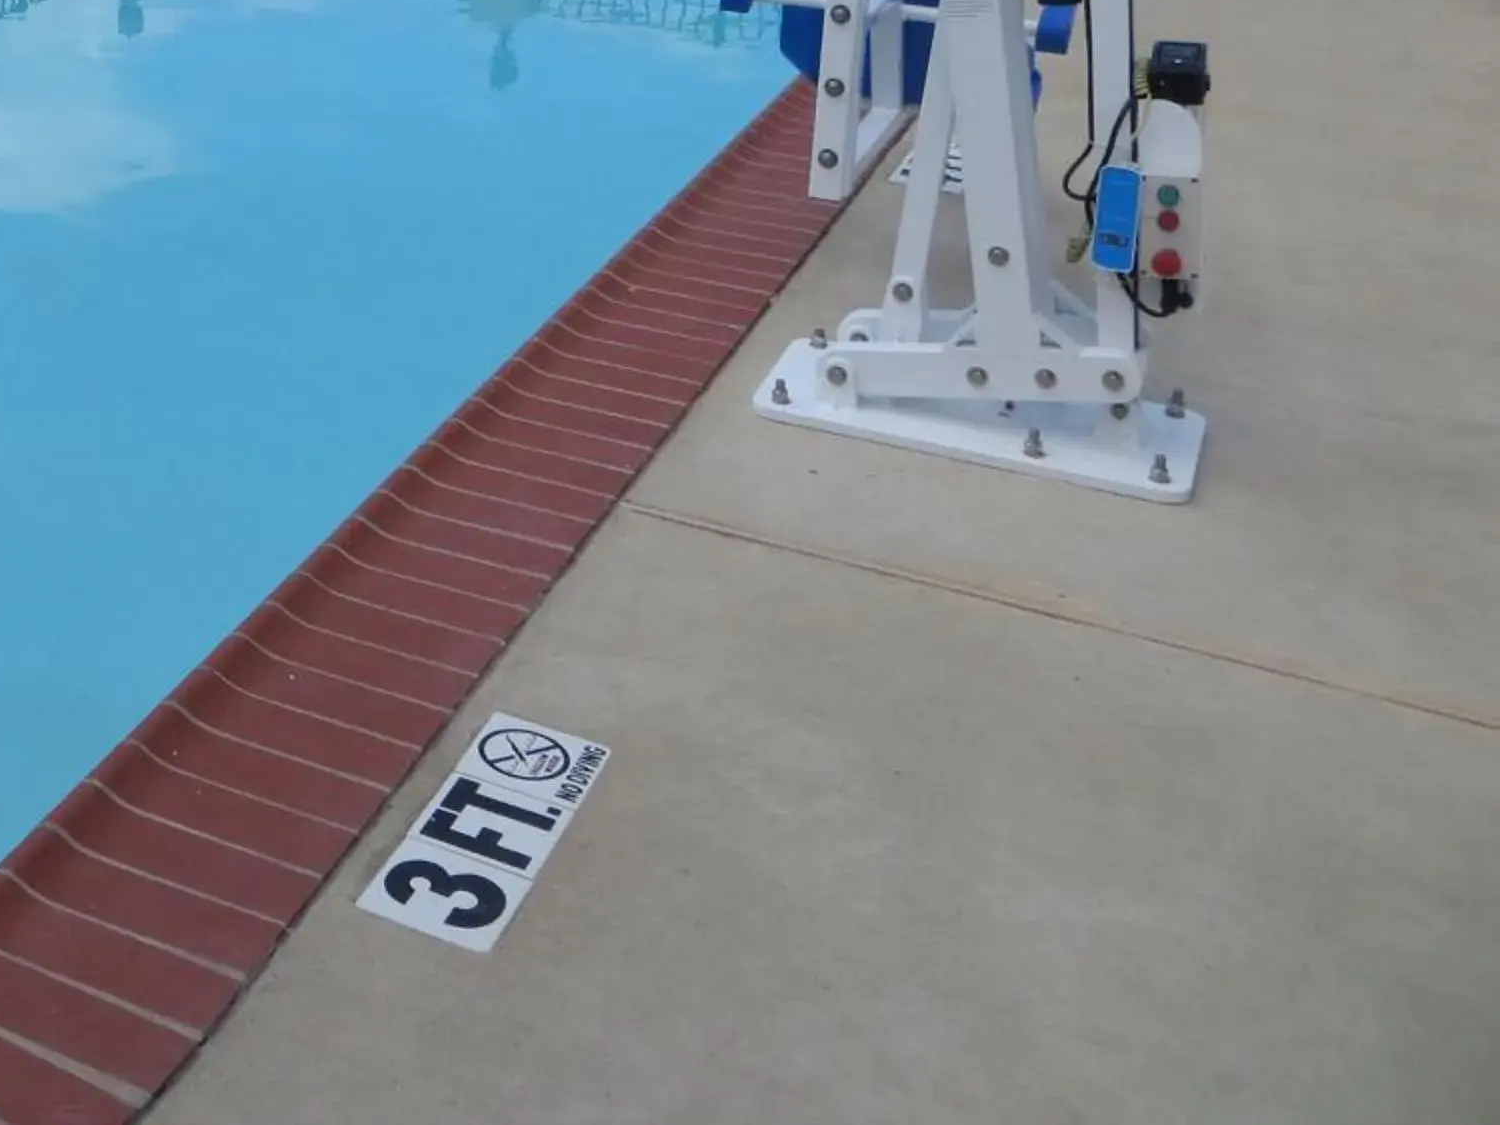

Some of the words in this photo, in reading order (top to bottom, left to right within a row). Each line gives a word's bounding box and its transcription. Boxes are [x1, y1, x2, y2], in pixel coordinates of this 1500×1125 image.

[567, 744, 606, 786] DIVING
[555, 782, 583, 803] NO
[384, 859, 506, 929] 3
